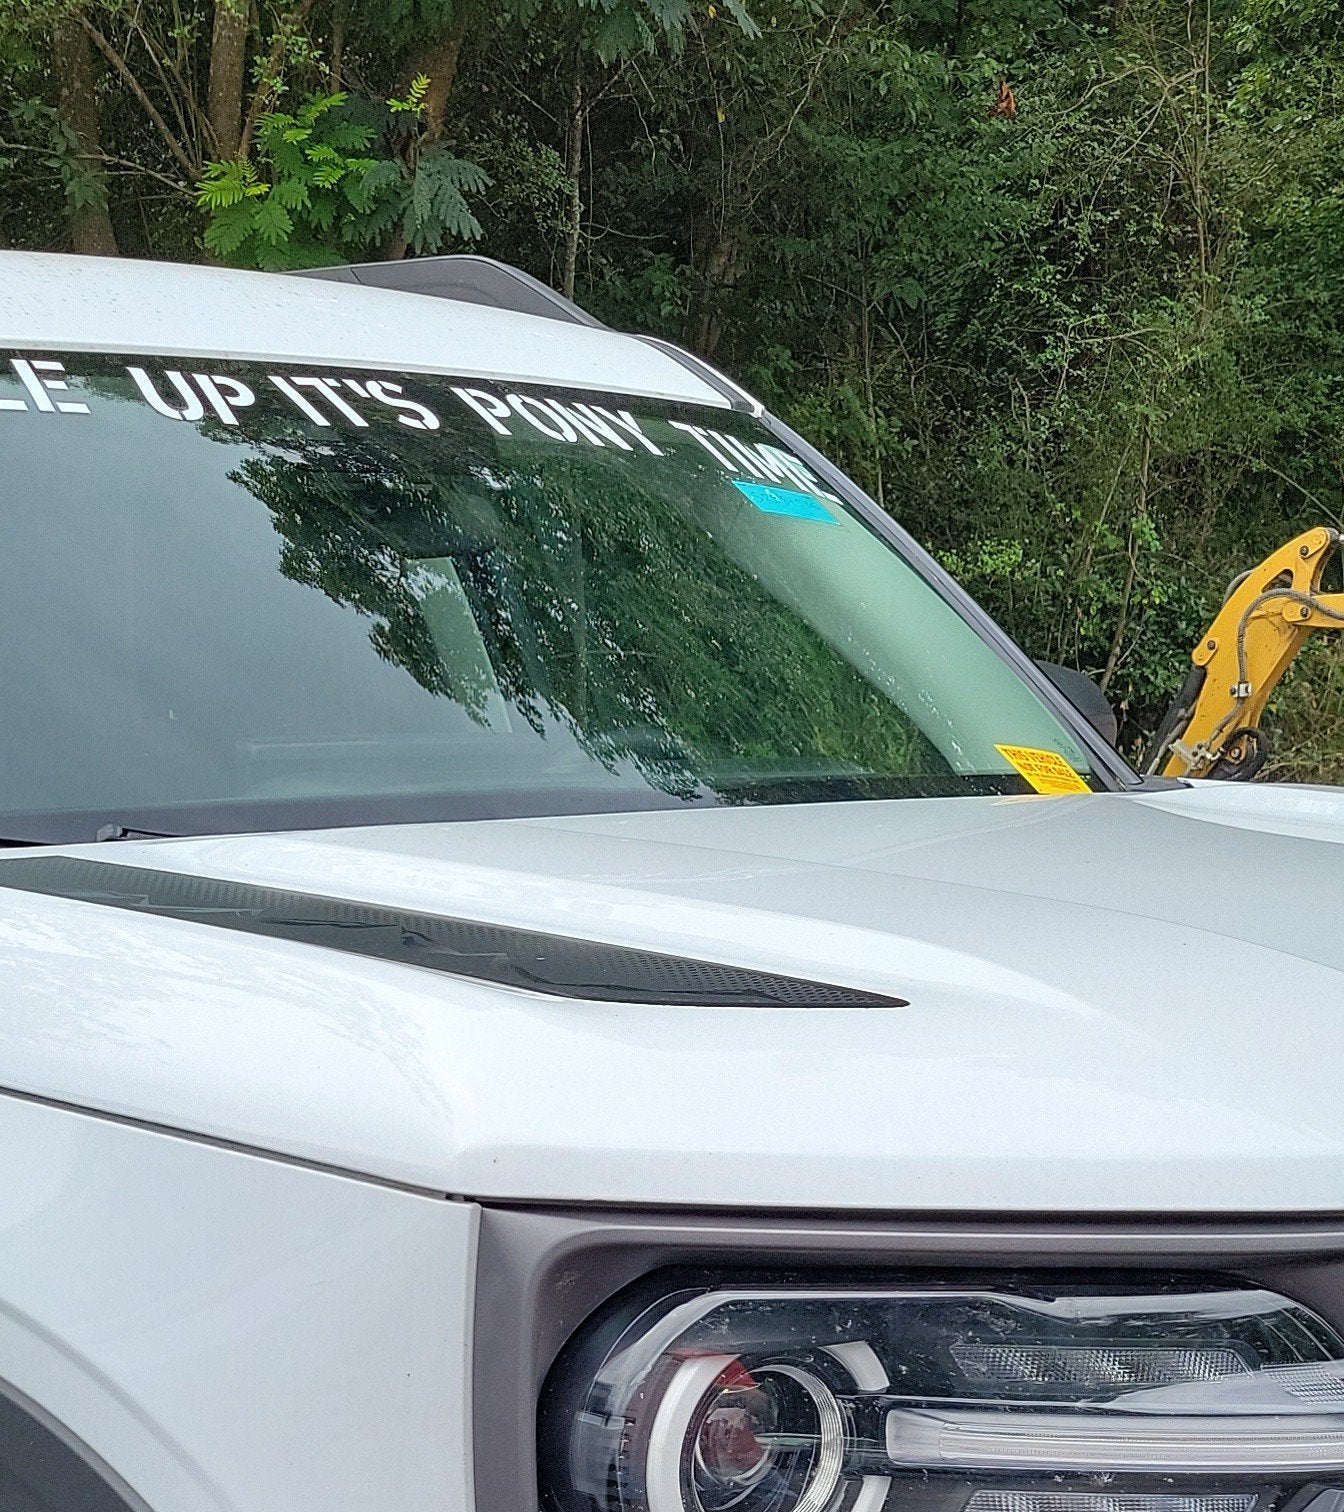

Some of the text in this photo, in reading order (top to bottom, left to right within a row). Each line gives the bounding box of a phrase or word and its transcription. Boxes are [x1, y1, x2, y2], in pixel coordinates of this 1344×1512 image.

[126, 366, 255, 426] UP
[267, 375, 441, 431] IT'S
[451, 386, 664, 457] PONY
[667, 420, 844, 505] TIME
